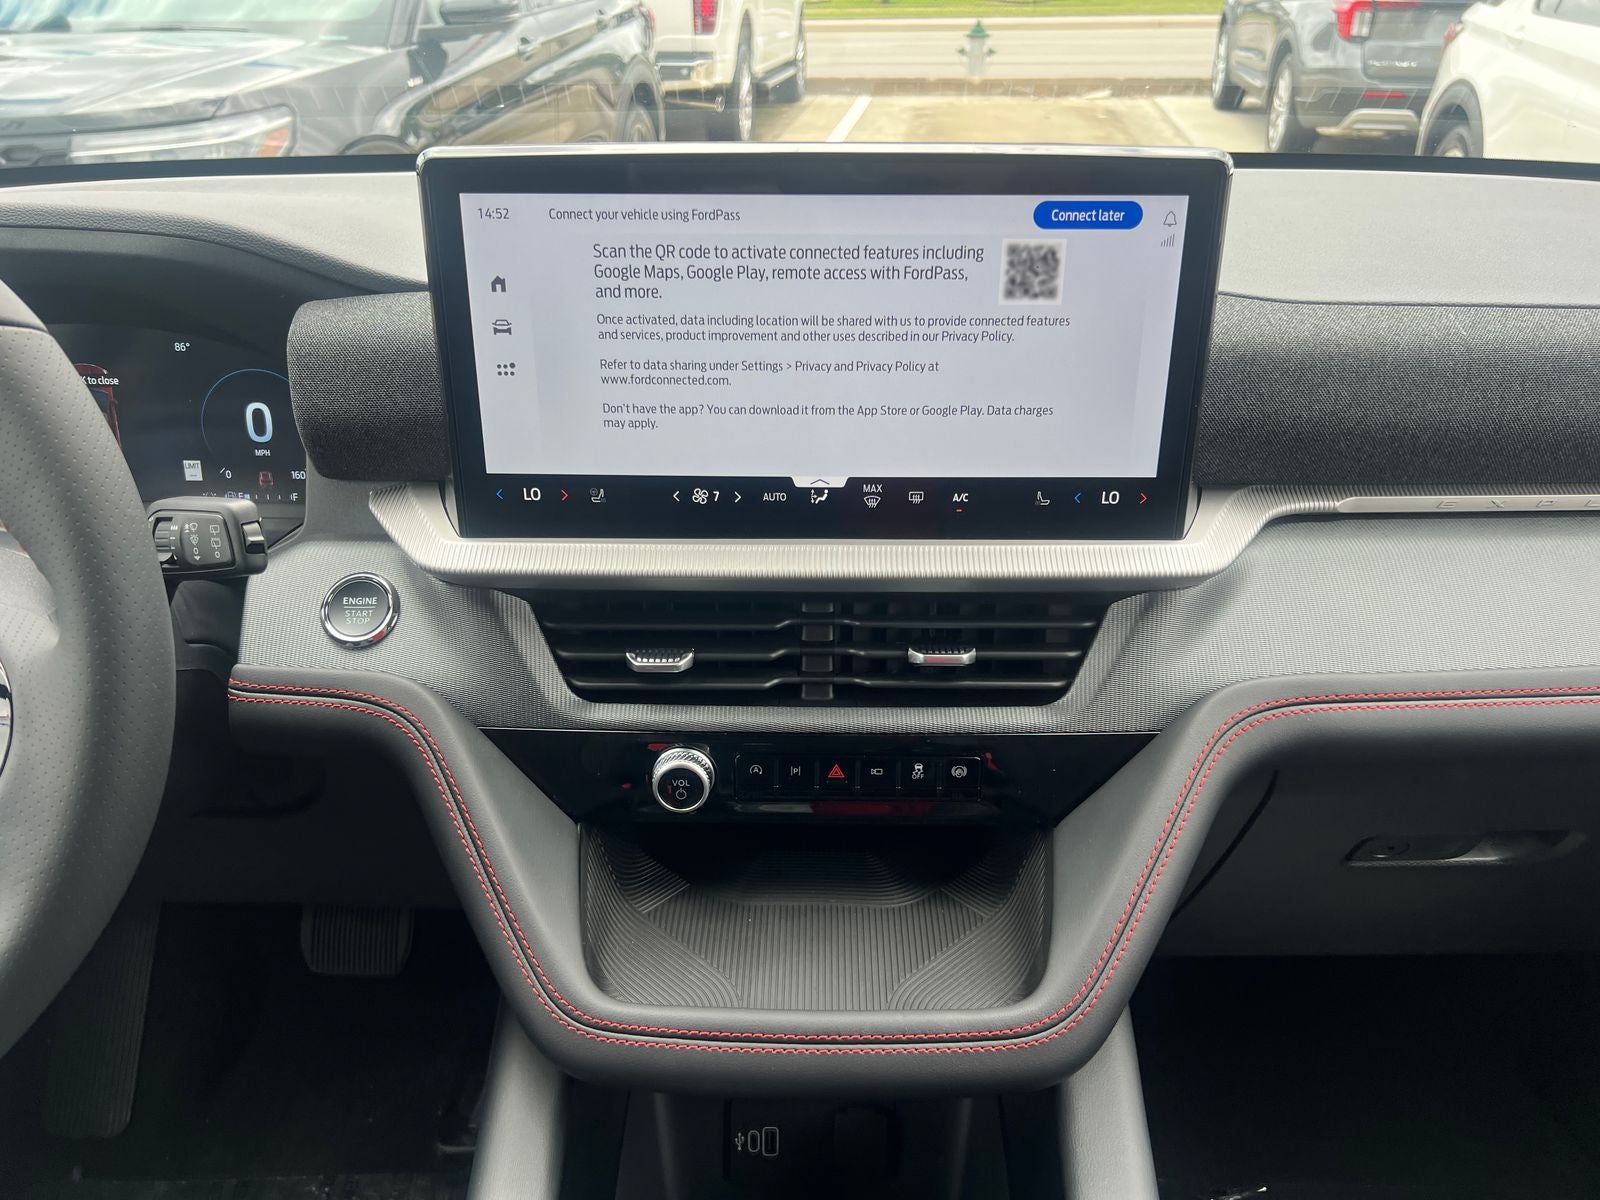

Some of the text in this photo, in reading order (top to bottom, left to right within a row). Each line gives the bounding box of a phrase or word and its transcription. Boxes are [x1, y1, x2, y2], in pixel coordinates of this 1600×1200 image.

[477, 208, 510, 220] 14:52
[549, 208, 740, 223] Connect your vehicle using FordPass
[1051, 209, 1125, 222] Connect later
[593, 243, 984, 262] Scan the QR code to activate connected features including
[594, 264, 968, 282] Google Maps, Google Play, remote access with FordPass,
[596, 284, 662, 299] and more.
[597, 314, 1070, 328] Once activated, data including location will be shared with us to provide connected features
[598, 329, 1015, 343] and services, product improvement and other uses described in our Privacy Policy.
[174, 342, 191, 352] 86°
[600, 359, 627, 370] Refer
[630, 360, 641, 371] to
[643, 360, 668, 371] data
[670, 360, 707, 372] sharing
[709, 360, 739, 372] under
[741, 360, 783, 373] Settings
[795, 361, 831, 373] Privacy
[834, 361, 853, 372] and
[856, 361, 893, 373] Privacy
[895, 361, 926, 373] Policy
[928, 362, 939, 372] at
[87, 376, 97, 385] to
[97, 375, 119, 385] close
[601, 374, 732, 386] www.fordconnected.com.
[603, 403, 1053, 417] Don't have the app? You can download it from the App Store or Google Play. Data charges
[245, 402, 273, 443] 0
[604, 418, 658, 430] may apply.
[255, 449, 271, 457] MPH
[226, 470, 232, 479] 0
[291, 471, 306, 480] 160
[523, 487, 541, 501] LO
[863, 484, 883, 493] MAX
[713, 491, 720, 502] 7
[763, 492, 787, 502] AUTO
[952, 492, 969, 503] A/C
[1101, 491, 1120, 505] LO
[343, 596, 378, 605] ENGINE
[344, 609, 374, 617] START
[346, 617, 371, 625] STOP
[671, 779, 691, 787] VOL
